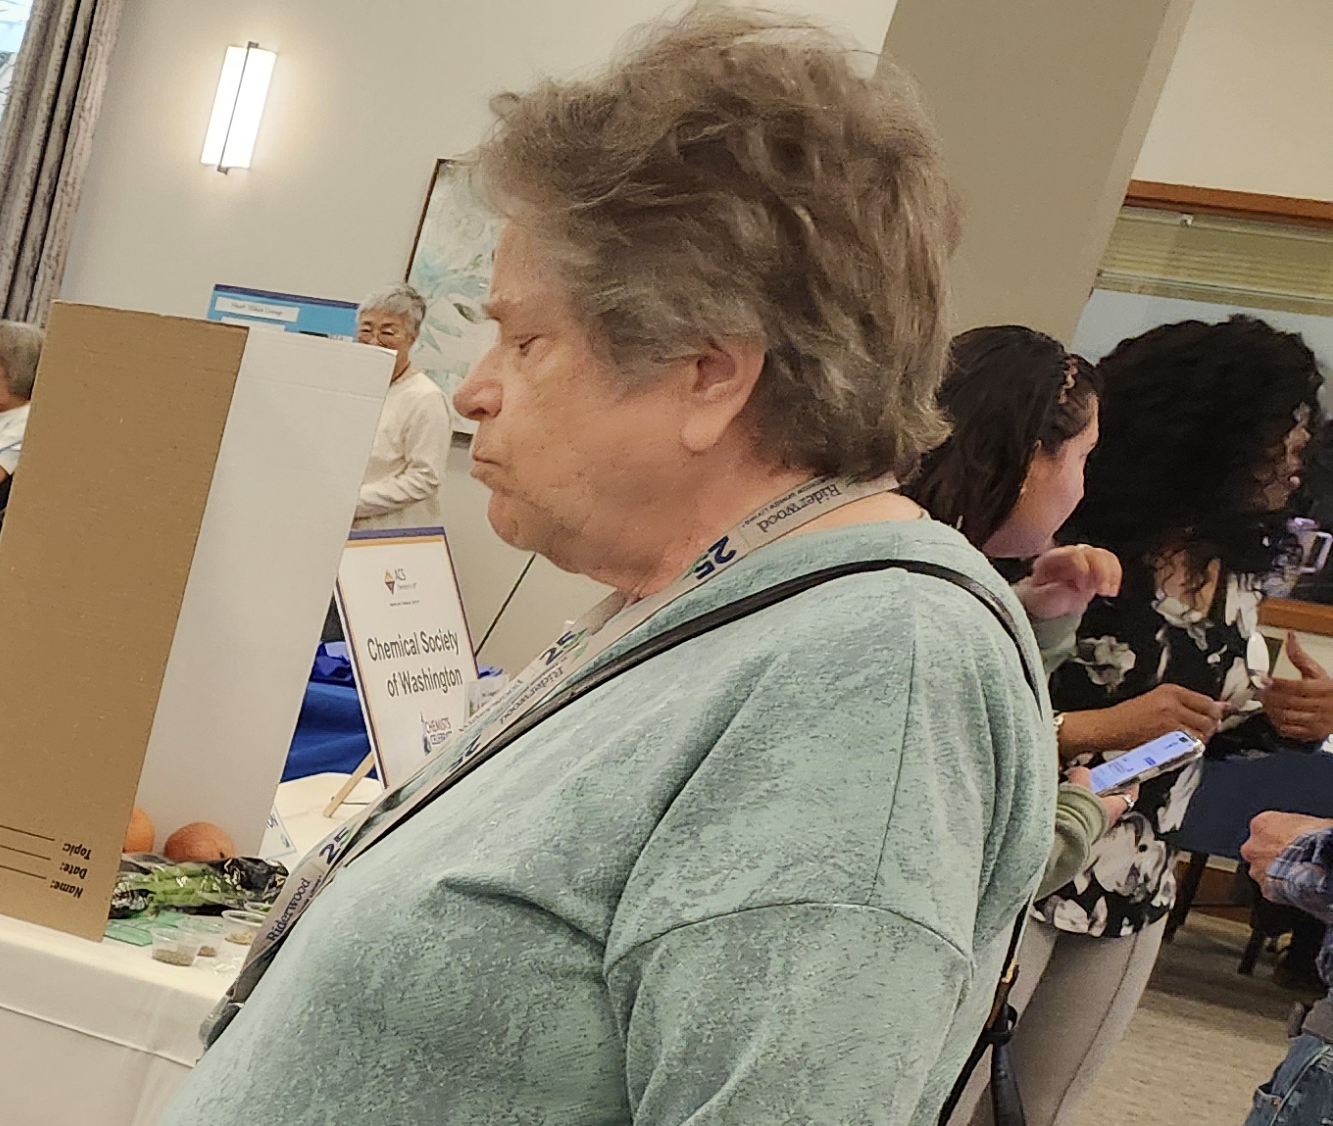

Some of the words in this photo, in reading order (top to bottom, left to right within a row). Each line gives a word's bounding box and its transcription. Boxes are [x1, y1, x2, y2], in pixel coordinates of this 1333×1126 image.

[757, 484, 842, 532] Riderwood
[693, 535, 737, 580] 25
[367, 631, 421, 662] Chemical
[420, 629, 459, 654] Society
[387, 679, 399, 698] of
[400, 667, 463, 693] Washington
[500, 664, 565, 724] Riderwood
[50, 880, 83, 899] Name:
[60, 862, 87, 879] Date:
[266, 877, 310, 942] Riderwood
